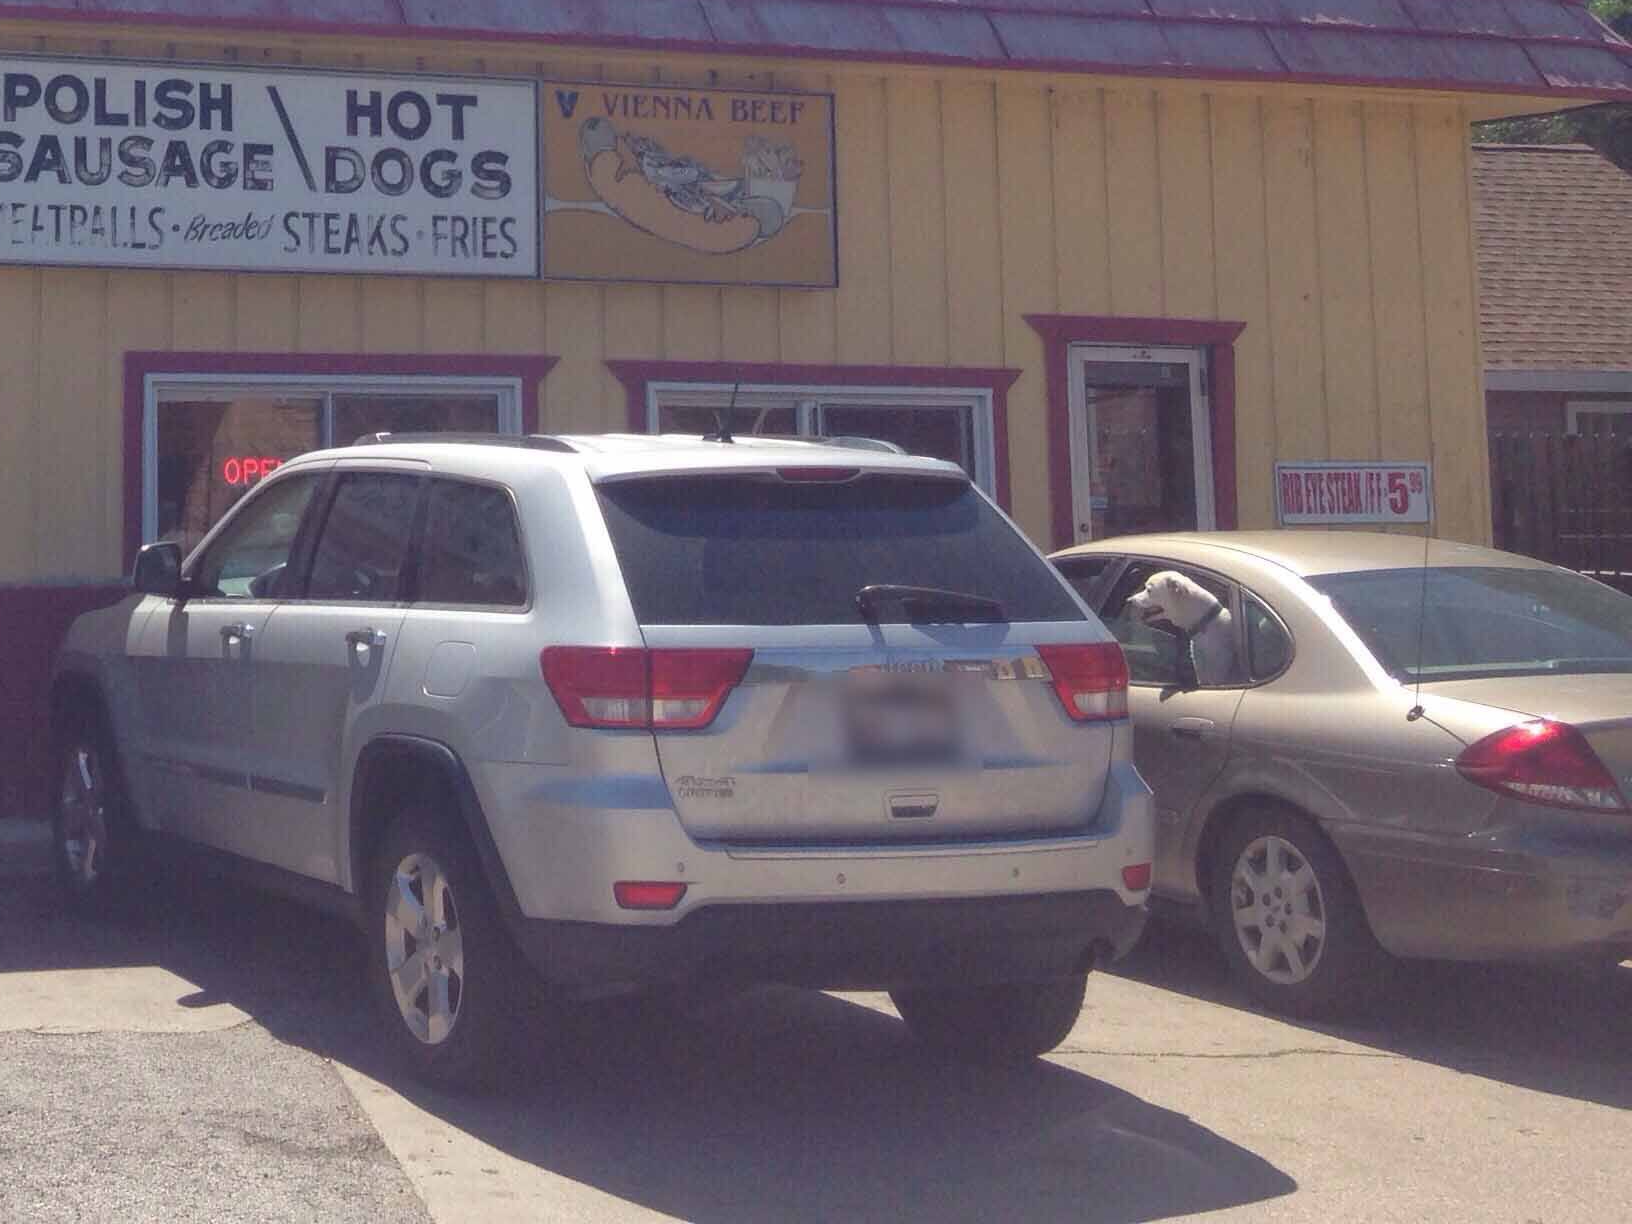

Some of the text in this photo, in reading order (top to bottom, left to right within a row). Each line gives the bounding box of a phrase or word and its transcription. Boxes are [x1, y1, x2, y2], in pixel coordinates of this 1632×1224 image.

[3, 74, 233, 132] POLISH
[345, 89, 478, 141] HOT
[601, 93, 715, 121] VIENNA
[730, 97, 806, 125] BEEF
[324, 145, 512, 200] DOGS
[183, 211, 274, 242] Breaded
[282, 210, 410, 257] STEAKS
[431, 215, 518, 260] FRIES
